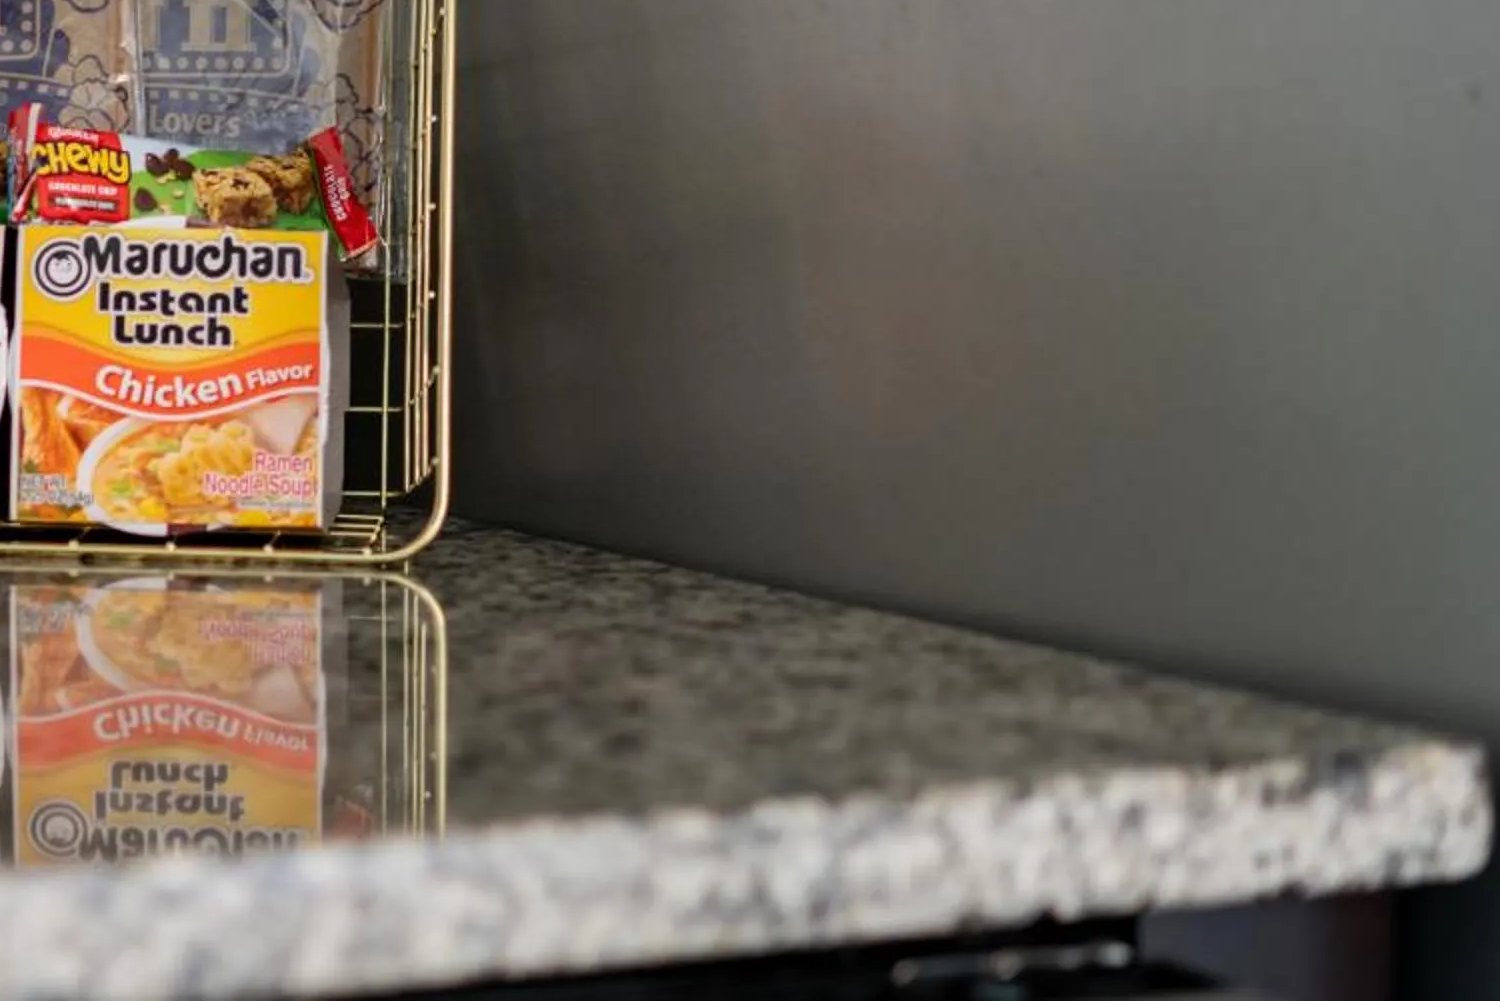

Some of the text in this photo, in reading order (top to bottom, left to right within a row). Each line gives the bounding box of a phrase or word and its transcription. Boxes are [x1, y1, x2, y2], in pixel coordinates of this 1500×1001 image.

[151, 104, 242, 139] Lovers
[83, 235, 303, 279] Maruchan
[99, 282, 249, 316] Instant
[113, 316, 232, 346] Lunch
[95, 363, 313, 408] Chicken Flavor
[255, 451, 313, 473] Ramen
[204, 473, 312, 498] Noodle Soup
